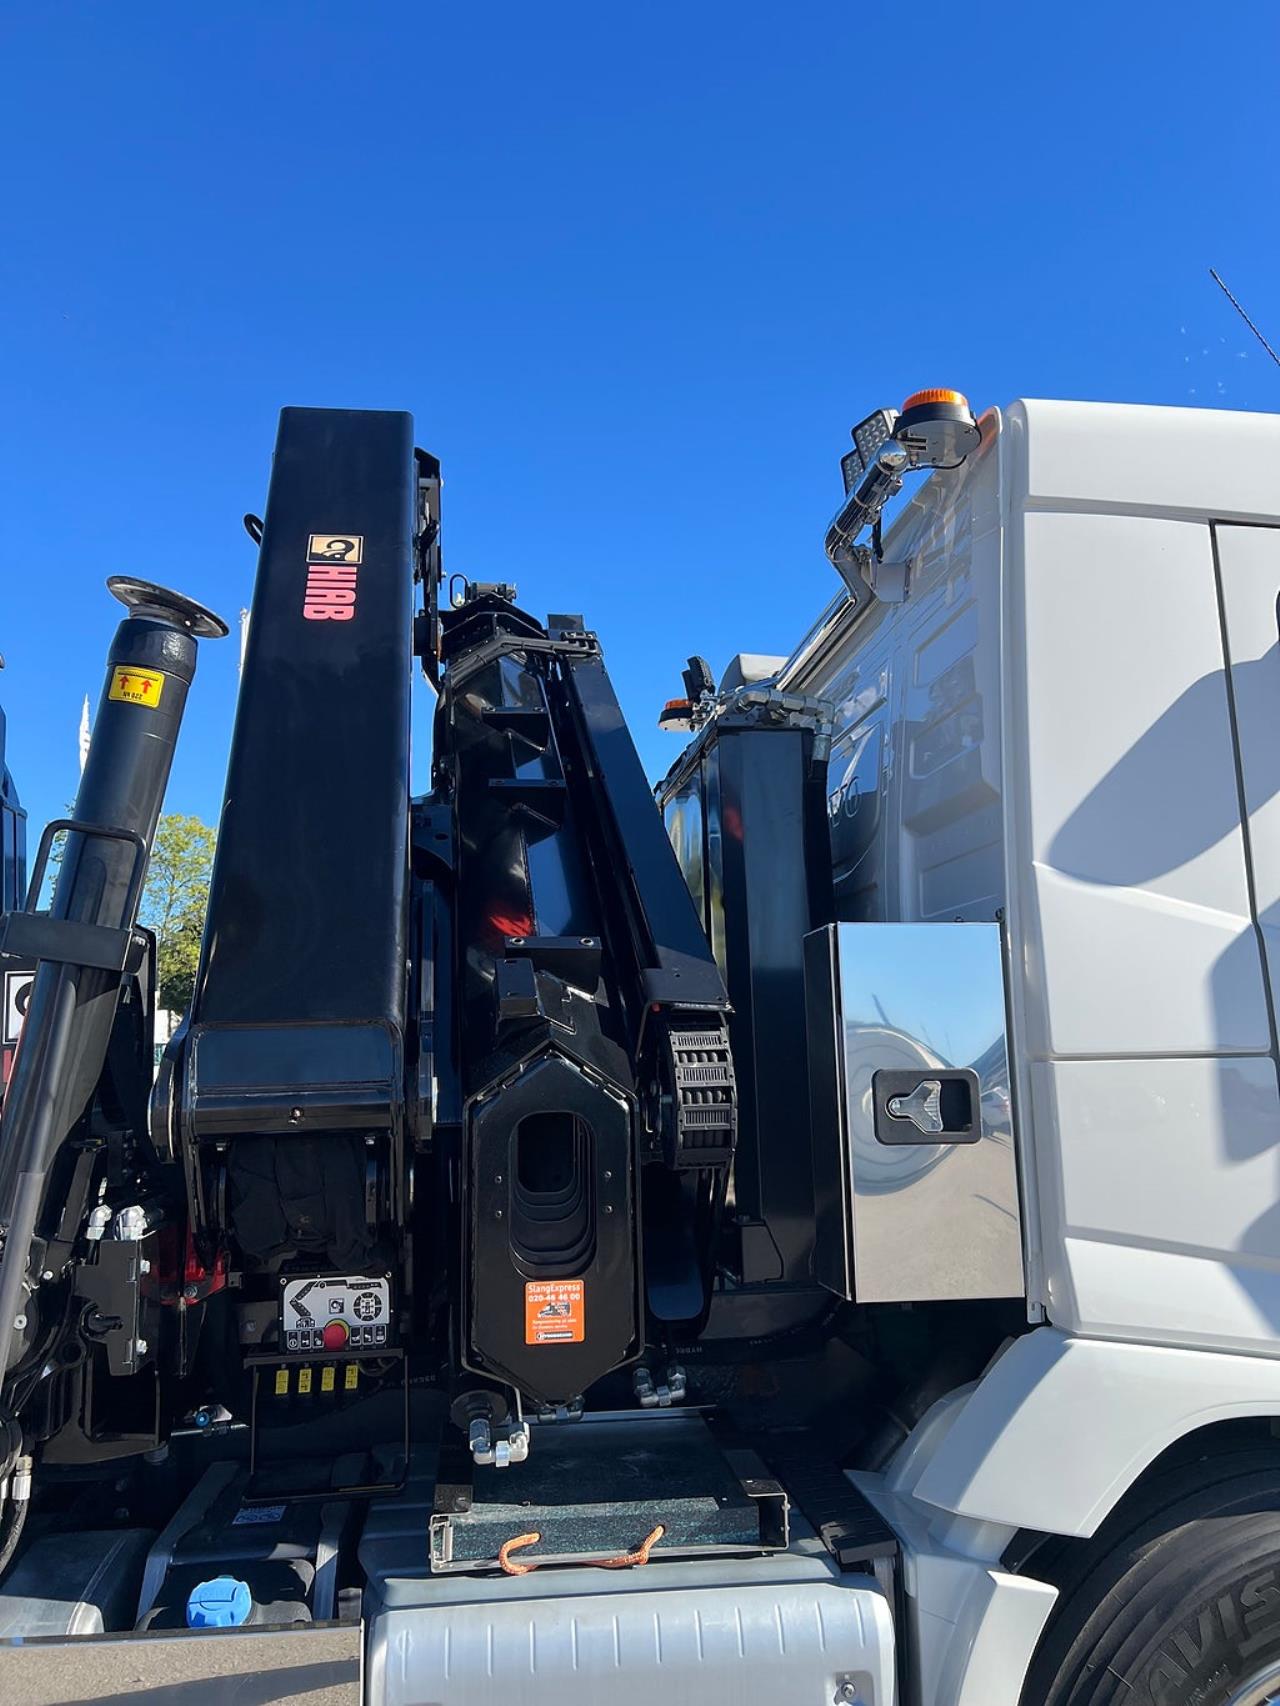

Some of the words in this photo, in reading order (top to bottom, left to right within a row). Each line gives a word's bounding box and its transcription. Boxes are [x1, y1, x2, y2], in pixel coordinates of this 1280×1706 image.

[303, 566, 357, 620] HIAB
[528, 1284, 580, 1294] SlangExpress
[528, 1294, 555, 1302] 020-46
[558, 1293, 568, 1301] 46
